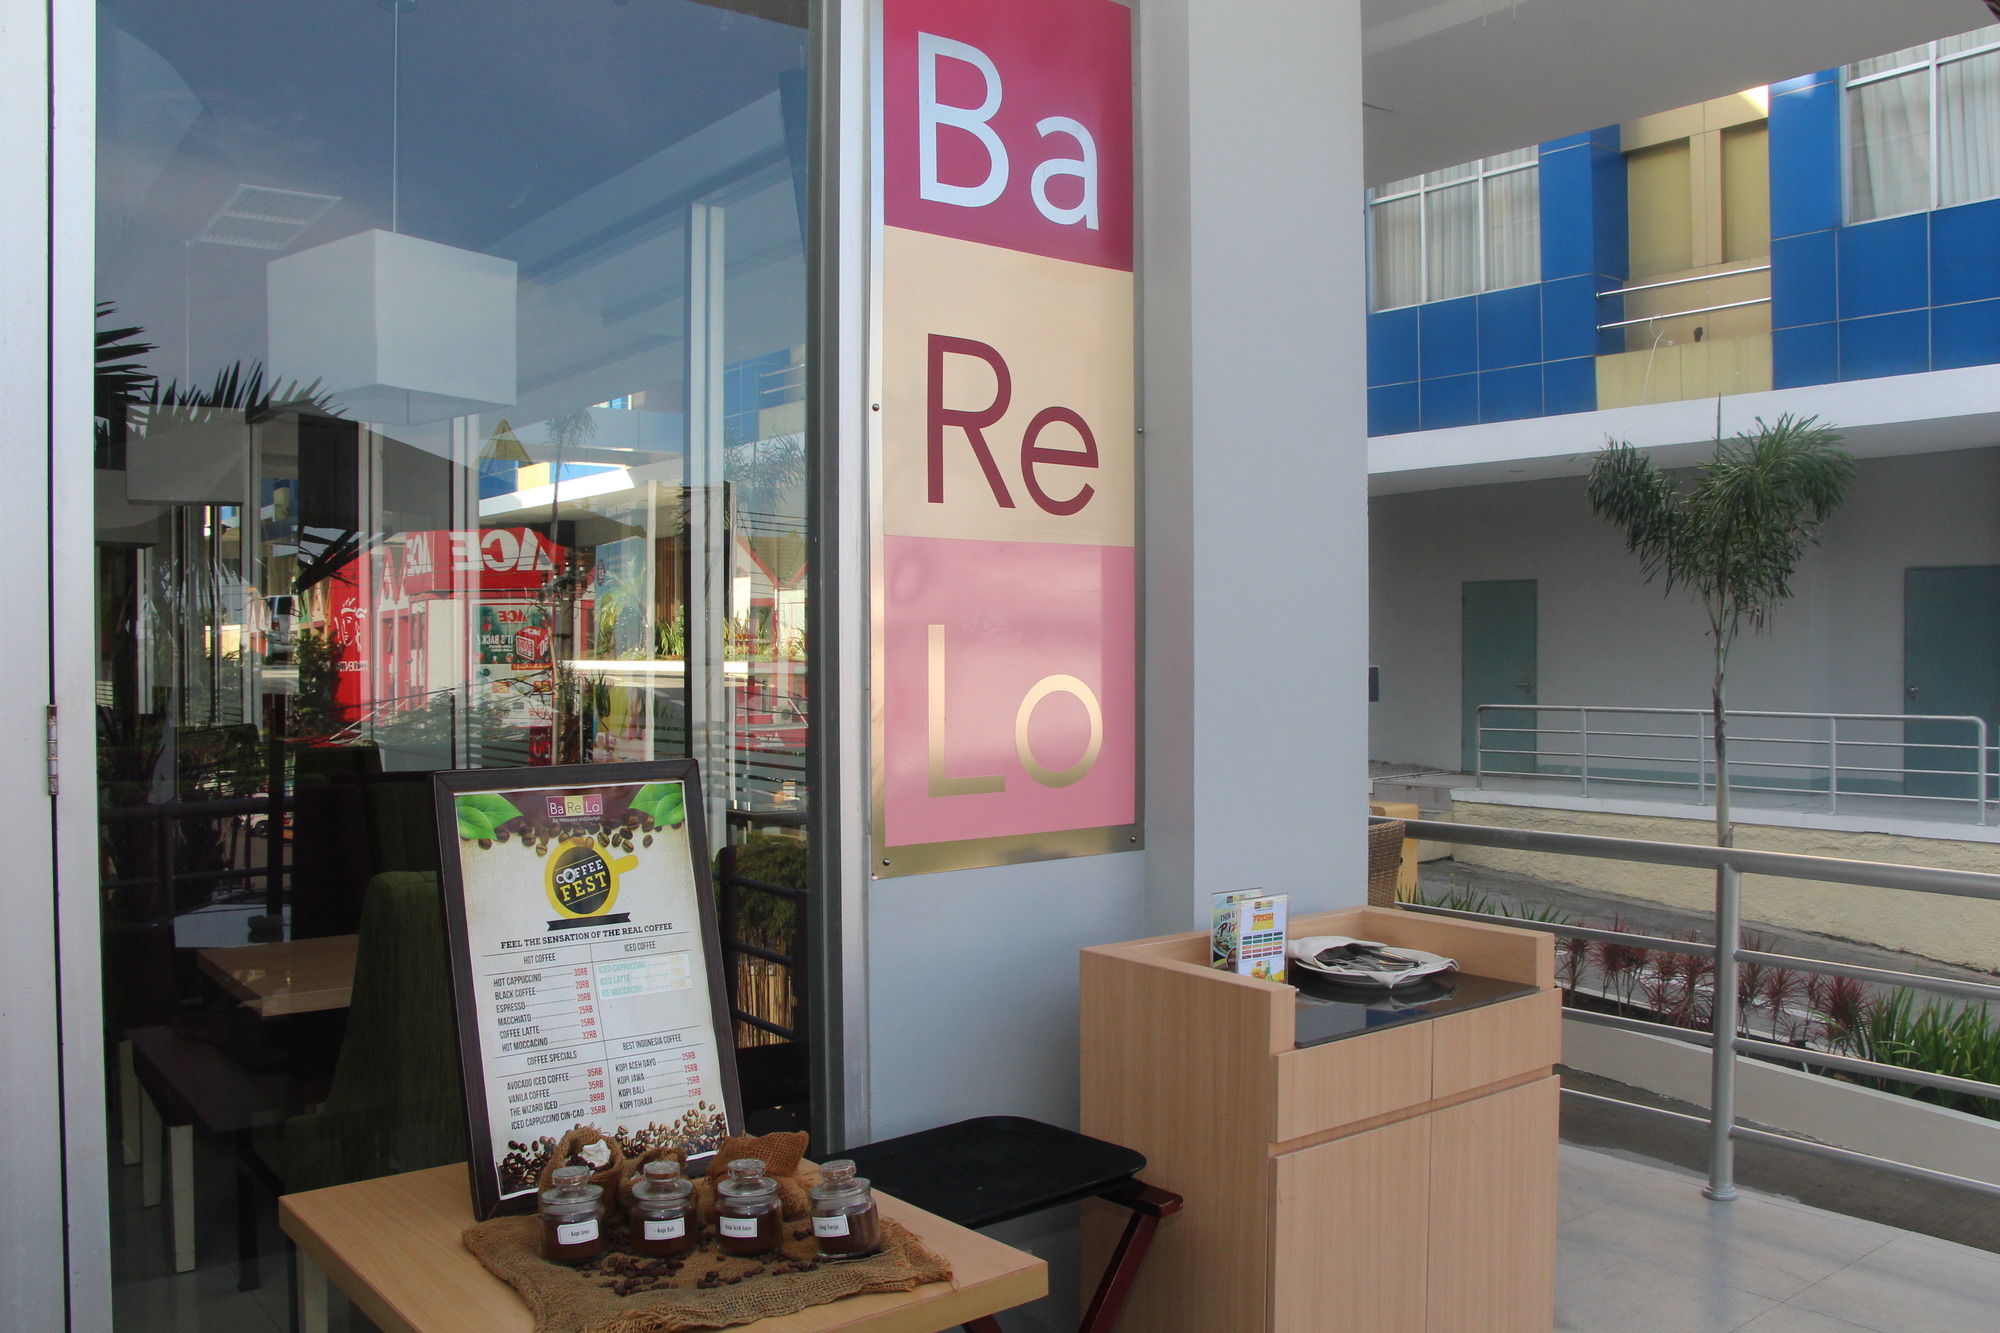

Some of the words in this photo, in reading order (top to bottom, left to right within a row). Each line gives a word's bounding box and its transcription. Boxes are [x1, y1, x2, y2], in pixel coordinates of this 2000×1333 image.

[918, 31, 1099, 231] Ba
[927, 333, 1099, 516] Re
[928, 624, 1103, 797] Lo
[556, 860, 604, 884] COFFEE
[560, 872, 607, 902] FEST
[1220, 913, 1230, 922] THIN
[501, 941, 522, 949] FEEL
[524, 938, 540, 946] THE
[542, 932, 590, 945] SENSATION
[591, 930, 601, 938] OF
[602, 928, 620, 937] THE
[622, 926, 641, 935] REAL
[644, 923, 672, 932] COFFEE
[624, 943, 636, 952] ICED
[638, 941, 656, 950] COFFEE
[524, 956, 534, 964] HOT
[535, 953, 556, 963] COFFEE
[494, 978, 505, 987] HOT
[506, 973, 541, 985] CAPPUCCINO
[574, 967, 588, 976] 30RB
[495, 990, 513, 1000] BLACK
[515, 987, 536, 997] COFFEE
[575, 980, 589, 989] 20RB
[496, 1002, 526, 1013] ESPRESSO
[498, 1014, 532, 1026] MACCHIATO
[579, 1005, 593, 1014] 25RB
[500, 1028, 521, 1039] COFFEE
[522, 1025, 540, 1035] LATTE
[502, 1043, 512, 1052] HOT
[514, 1037, 548, 1049] MOCCACINO
[582, 1030, 597, 1040] 32RB
[622, 1042, 635, 1050] BEST
[636, 1037, 663, 1049] INDONESIA
[663, 1034, 682, 1044] COFFEE
[527, 1054, 548, 1066] COFFEE
[549, 1050, 577, 1062] SPECIALS
[615, 1063, 628, 1072] KOPI
[629, 1060, 642, 1070] ACEH
[643, 1058, 656, 1067] GAYO
[682, 1051, 696, 1061] 25RB
[507, 1079, 532, 1090] AVOCADO
[533, 1077, 547, 1086] ICED
[547, 1072, 569, 1084] COFFEE
[587, 1067, 603, 1077] 35RB
[617, 1076, 630, 1085] KOPI
[630, 1073, 645, 1082] JAWA
[684, 1063, 698, 1073] 25RB
[508, 1093, 528, 1104] VANILA
[529, 1089, 550, 1100] COFFEE
[588, 1080, 604, 1090] 35RB
[618, 1088, 632, 1098] KOPI
[633, 1086, 644, 1095] BALI
[620, 1100, 633, 1110] KOPI
[635, 1097, 653, 1108] TORAJA
[688, 1088, 701, 1097] 25RB
[510, 1108, 520, 1117] THE
[522, 1103, 543, 1114] WIZARD
[544, 1101, 558, 1109] ICED
[511, 1121, 524, 1130] ICED
[525, 1114, 560, 1127] CAPPUCCINO
[560, 1109, 585, 1121] CIN-CAO
[590, 1105, 606, 1115] 35RB
